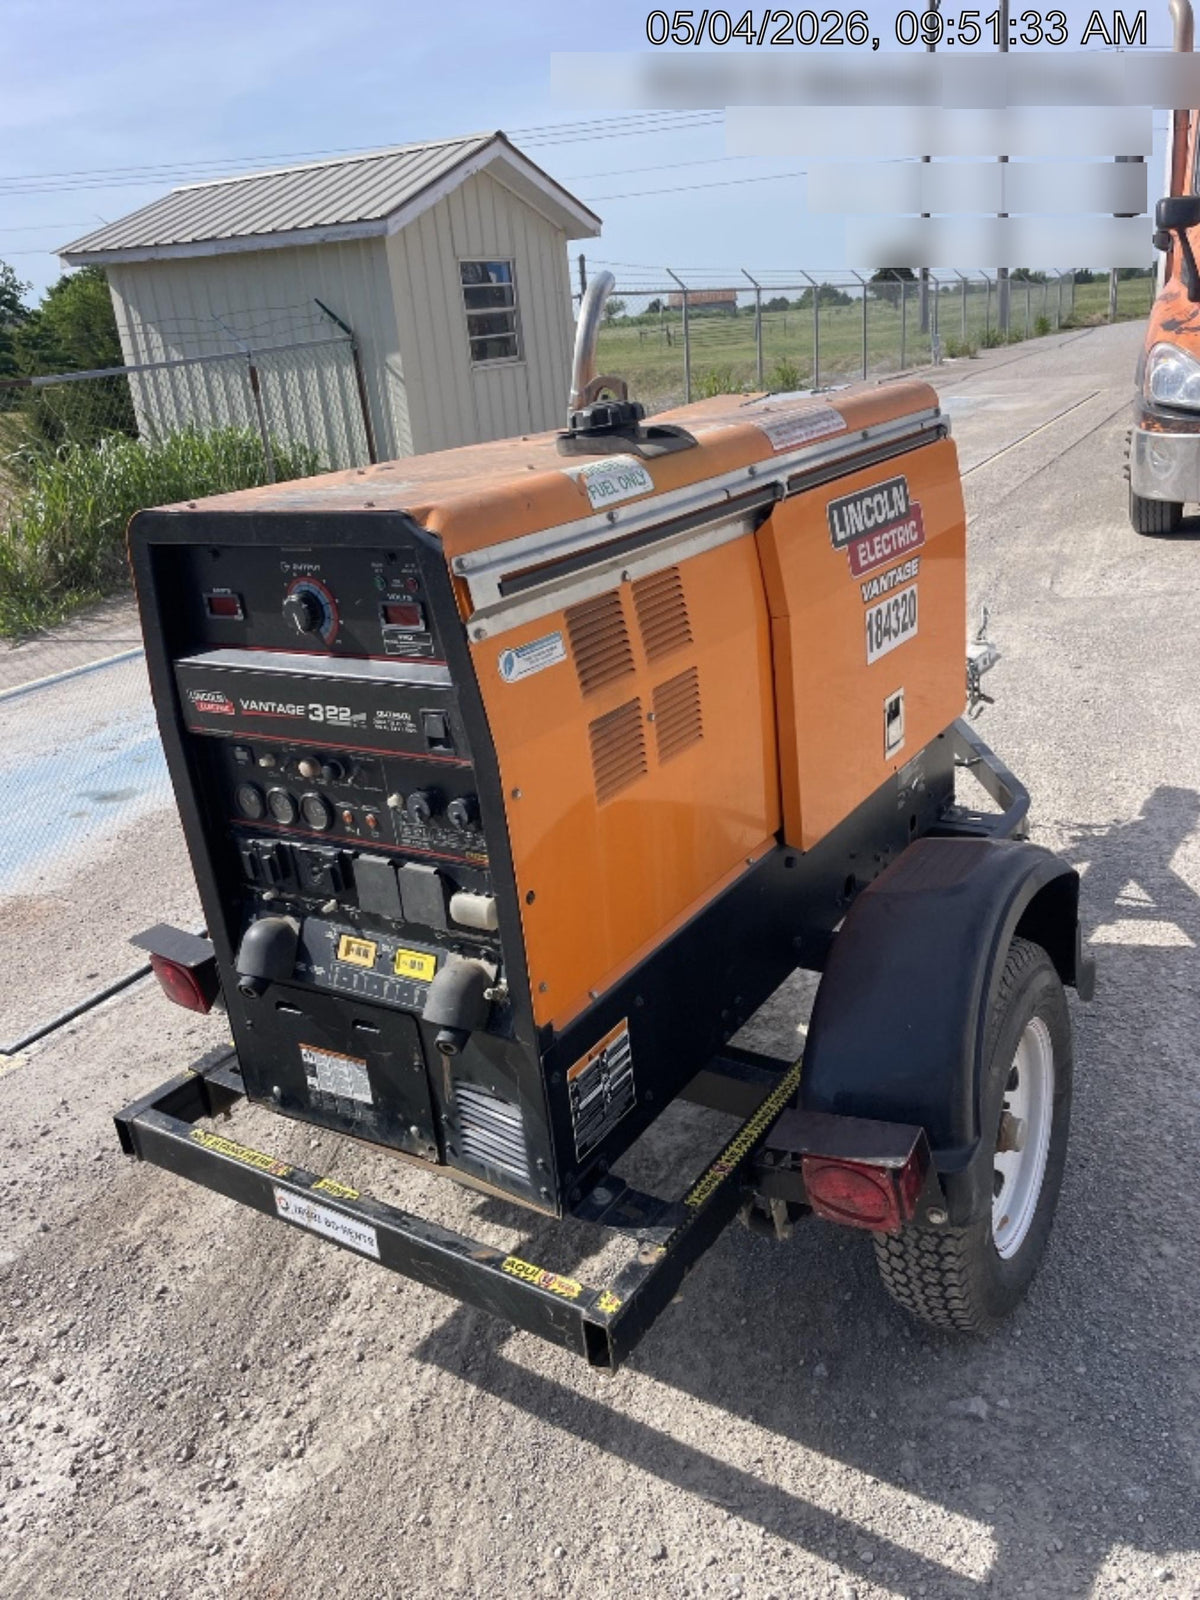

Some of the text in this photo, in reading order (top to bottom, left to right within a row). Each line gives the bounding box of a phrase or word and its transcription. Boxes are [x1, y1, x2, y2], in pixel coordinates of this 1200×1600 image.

[588, 470, 647, 500] FUEL ONLY
[832, 485, 906, 542] LINCOLN
[858, 520, 919, 568] ELECTRIC
[861, 556, 920, 604] VANTAGE
[867, 589, 917, 653] 184320
[240, 698, 305, 716] VANTAGE
[308, 703, 351, 723] 322
[505, 1258, 542, 1279] AQUI
